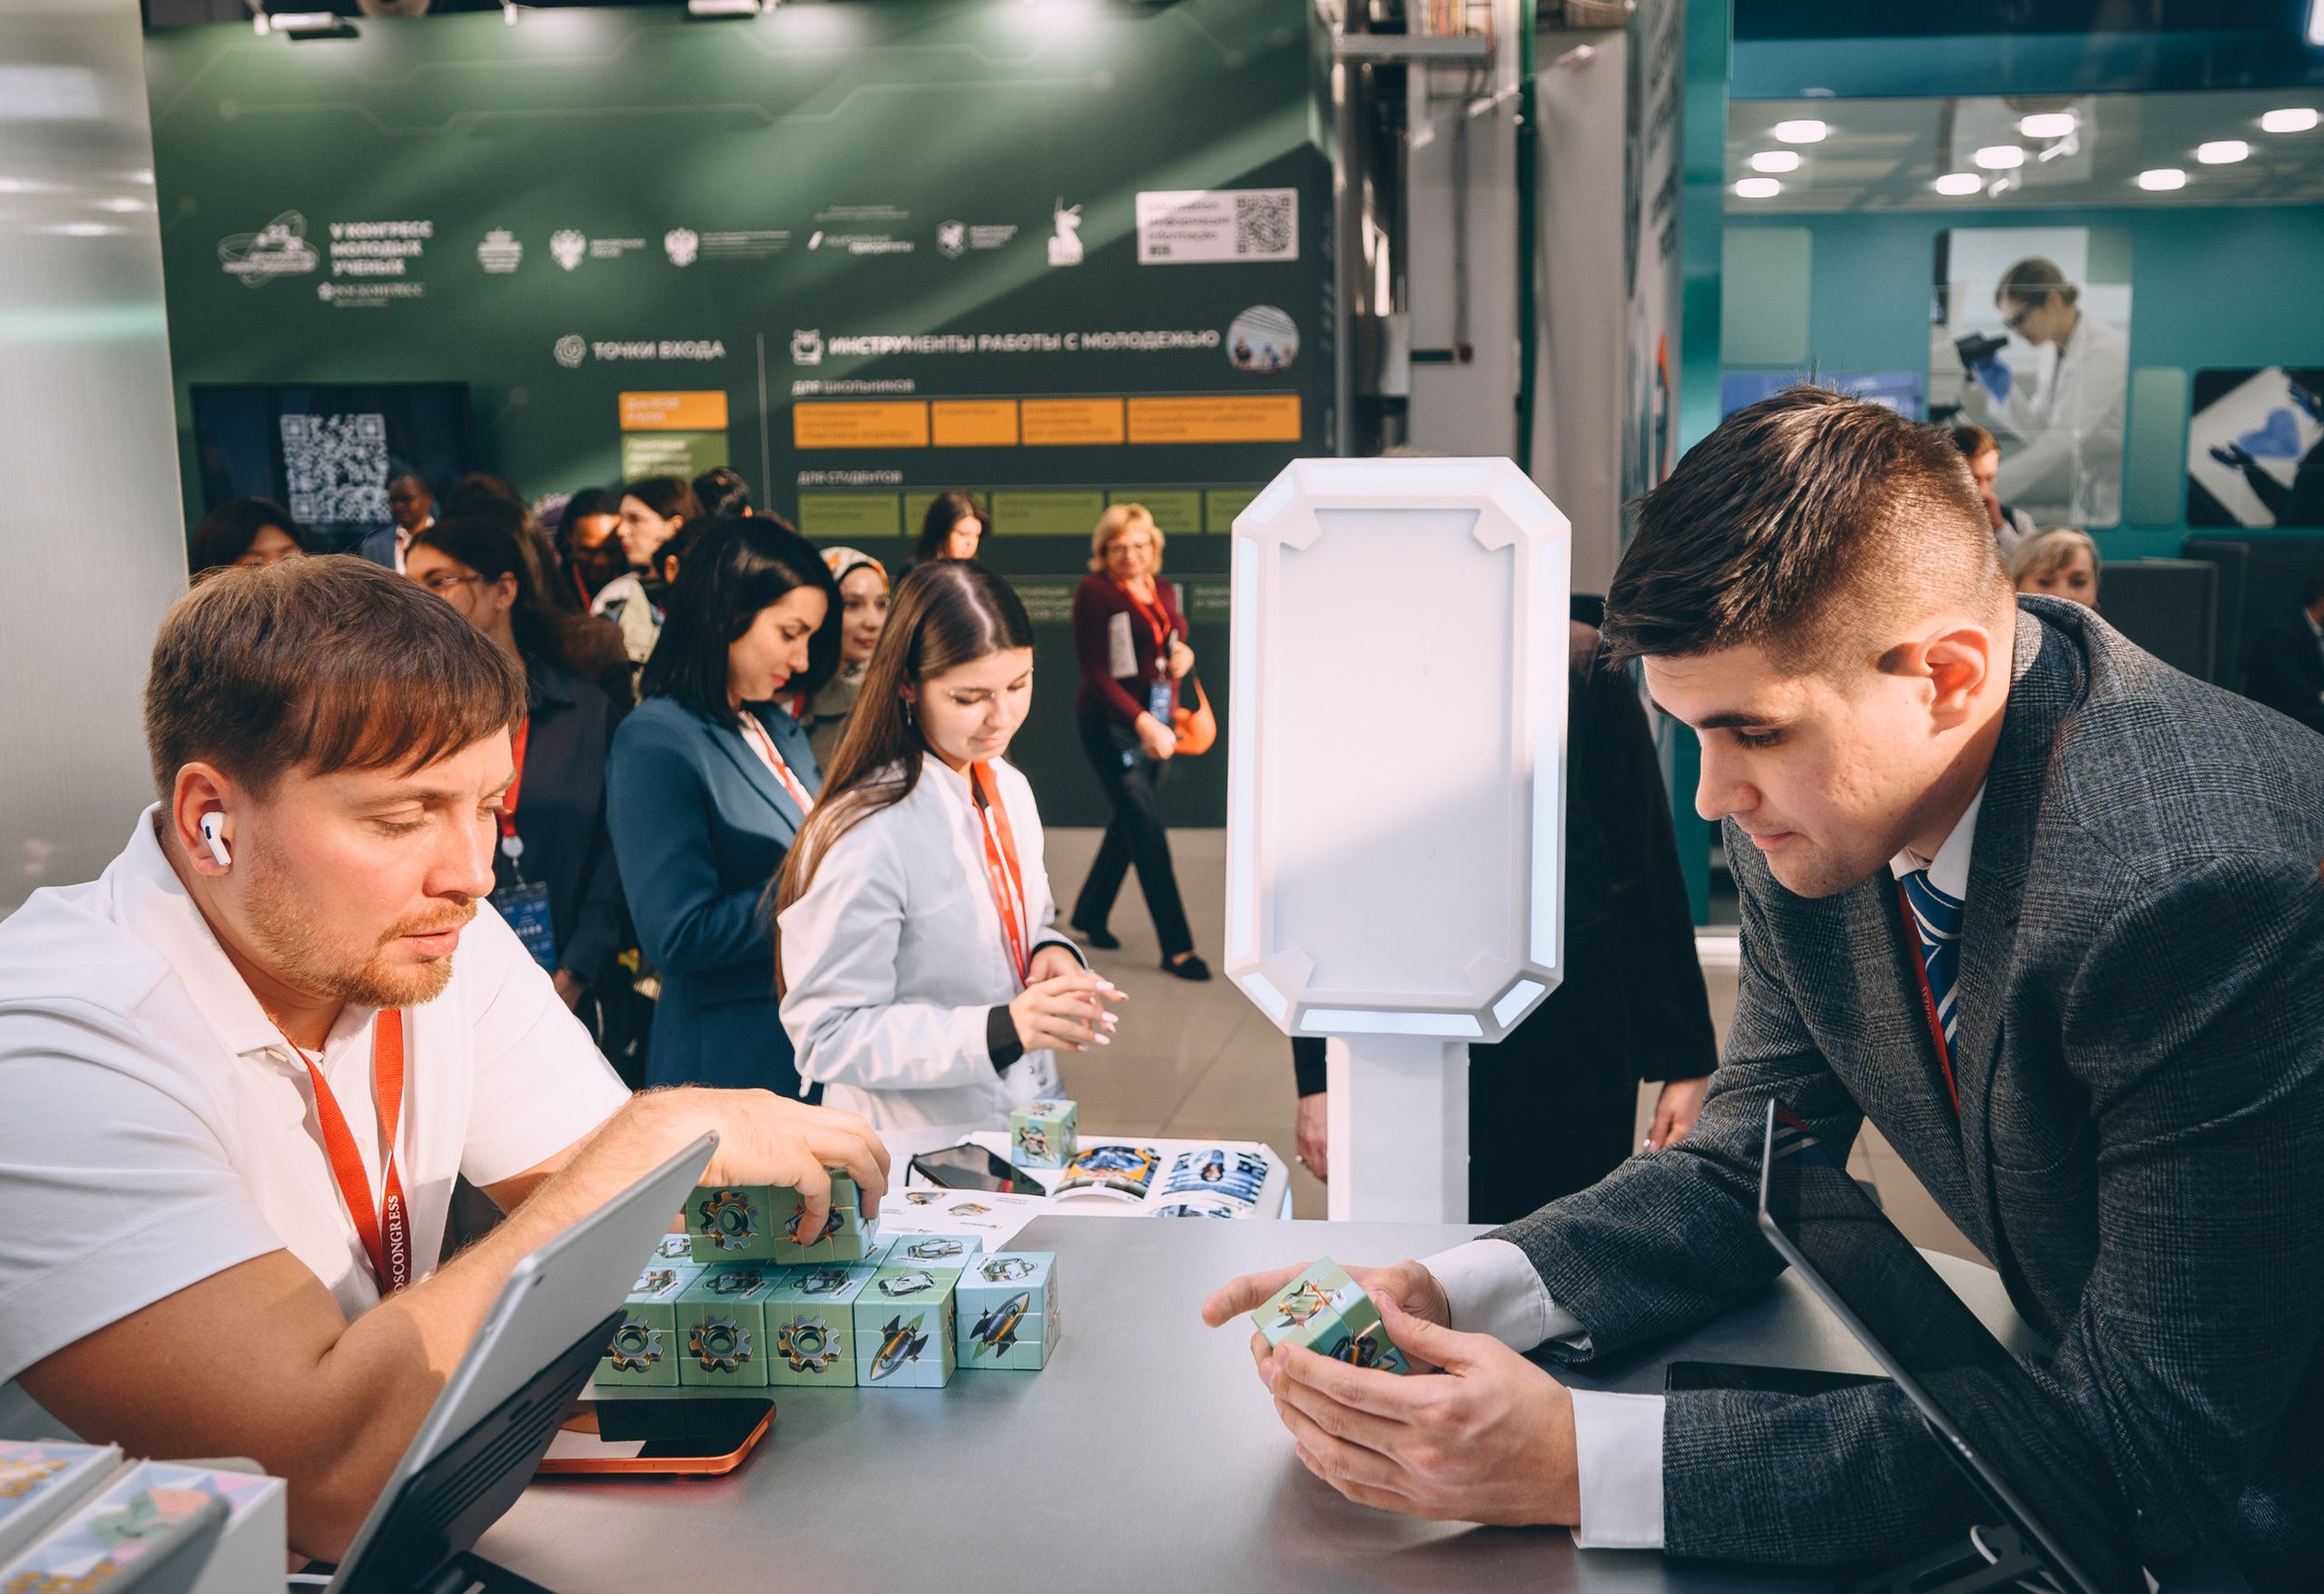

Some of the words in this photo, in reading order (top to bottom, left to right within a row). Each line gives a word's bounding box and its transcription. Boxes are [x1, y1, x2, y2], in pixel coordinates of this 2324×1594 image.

[345, 221, 434, 239] КОНГРЕСС
[330, 241, 423, 258] МОЛОДЫХ
[332, 258, 407, 276] УЧЕНЫХ
[593, 341, 656, 360] ТОЧКИ
[658, 339, 726, 361] ВХОДА
[829, 335, 975, 355] ИНСТРУМЕНТЫ
[978, 333, 1061, 352] РАБОТЫ
[1063, 332, 1079, 350] С
[1081, 330, 1221, 351] МОЛОДЕЖЬЮ
[792, 380, 821, 396] ДЛЯ
[797, 471, 823, 487] ДЛЯ
[825, 469, 902, 486] СТУДЕНТОВ
[388, 1195, 406, 1294] OSCONGRESS
